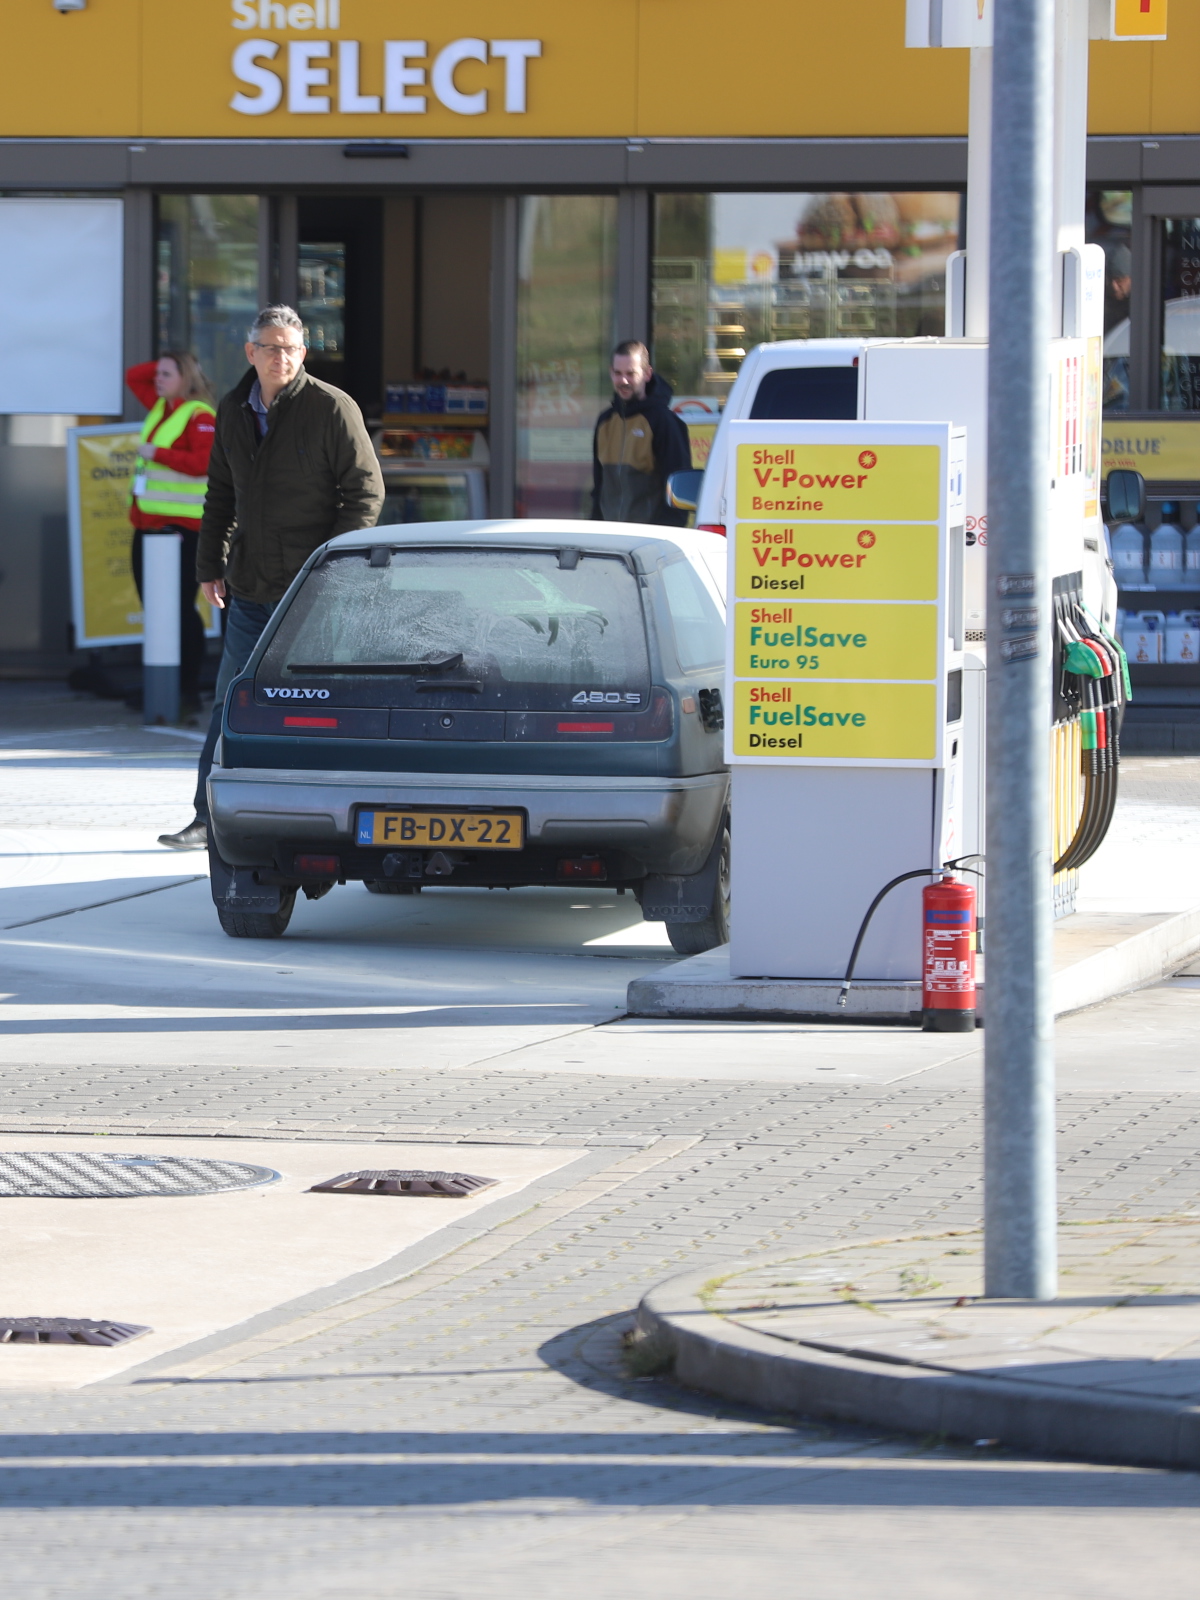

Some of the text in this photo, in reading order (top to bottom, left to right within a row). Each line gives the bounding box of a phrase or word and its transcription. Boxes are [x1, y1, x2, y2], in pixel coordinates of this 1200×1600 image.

[231, 0, 340, 30] Shell
[229, 37, 542, 116] SELECT
[753, 450, 795, 465] Shell
[754, 468, 868, 489] V-Power
[752, 496, 824, 511] Benzine
[752, 529, 794, 544] Shell
[753, 547, 867, 568] V-Power
[751, 575, 805, 590] Diesel
[750, 608, 793, 623] Shell
[750, 625, 867, 648] FuelSave
[750, 655, 819, 670] Euro 95
[263, 688, 330, 699] VOLVO
[750, 687, 792, 702] Shell
[749, 704, 867, 727] FuelSave
[749, 733, 802, 748] Diesel
[360, 816, 511, 843] NL FB-DX-22
